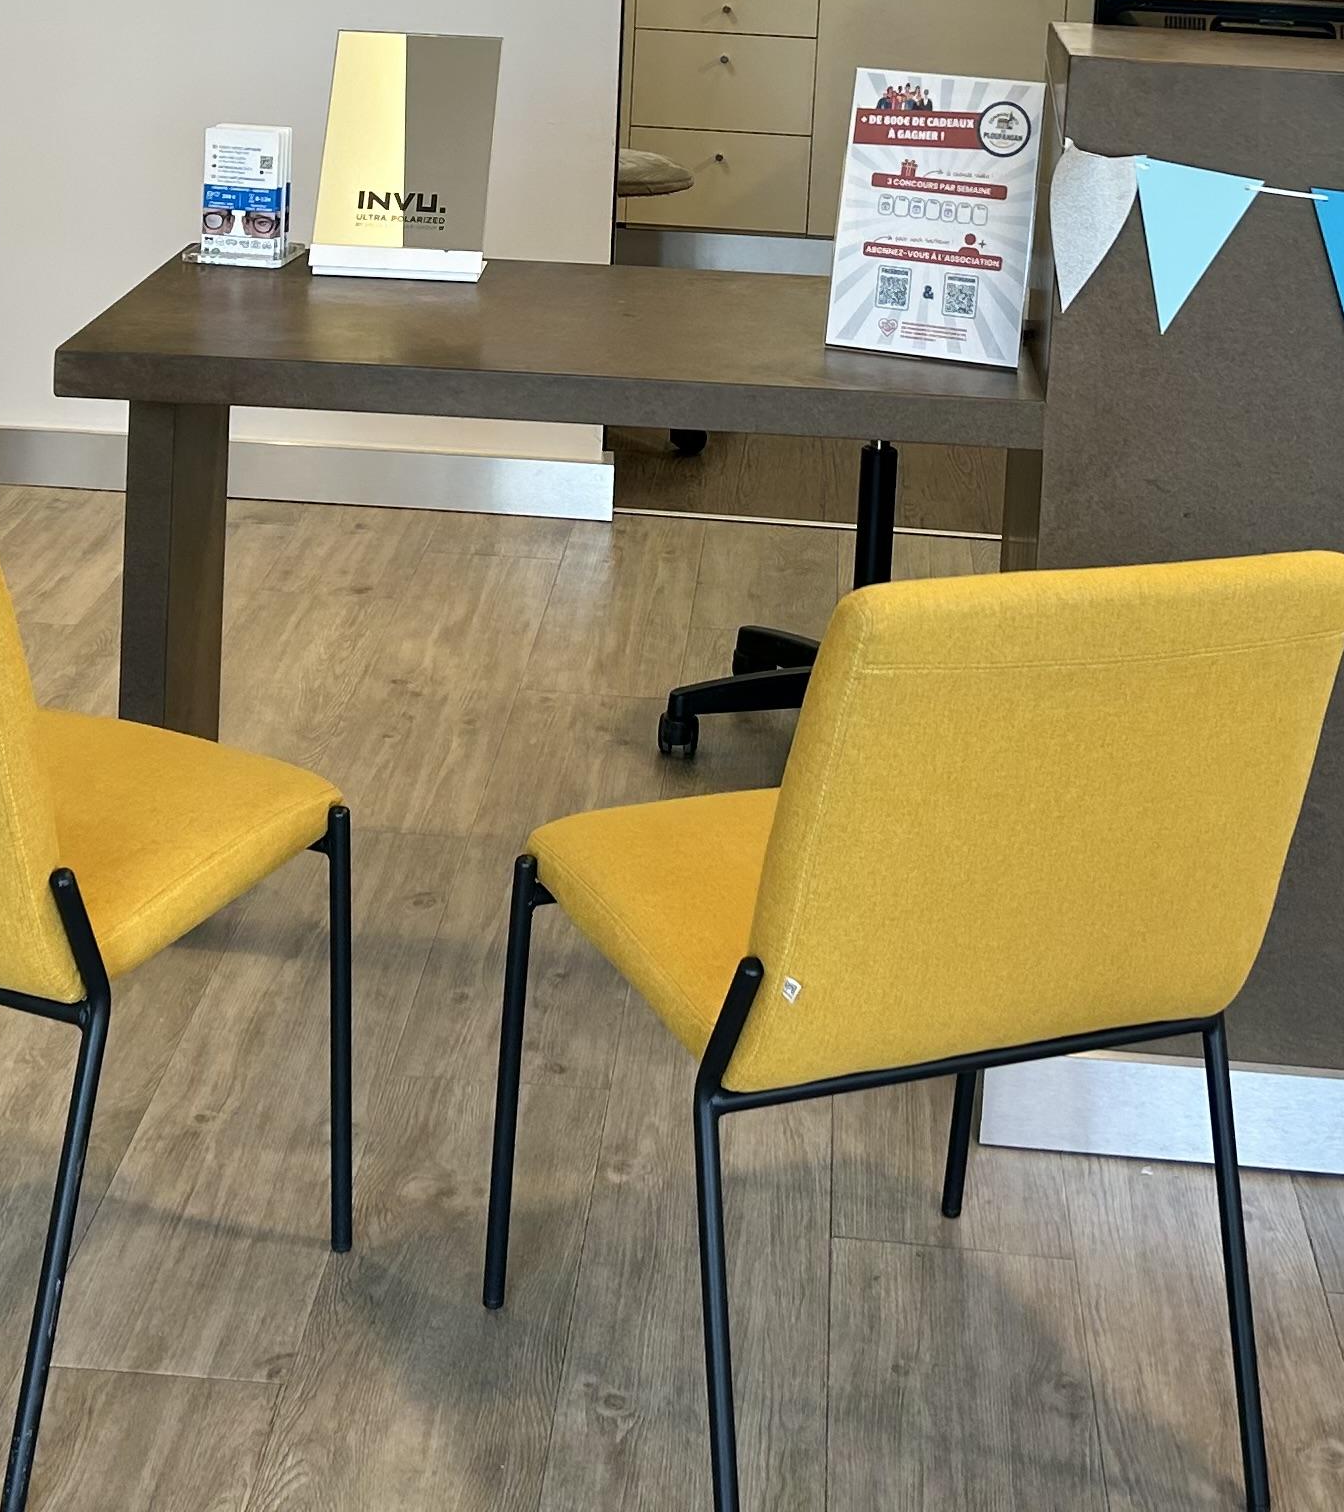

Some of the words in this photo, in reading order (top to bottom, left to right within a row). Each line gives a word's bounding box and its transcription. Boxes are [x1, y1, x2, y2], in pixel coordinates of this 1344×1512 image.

[869, 115, 882, 124] DE
[911, 117, 925, 127] DE
[926, 117, 975, 129] CADEAUX
[888, 128, 896, 139] À
[897, 130, 939, 141] GAGNER
[893, 179, 938, 190] CONCOURS
[940, 184, 956, 193] PAR
[957, 185, 992, 195] SEMAINE
[391, 215, 446, 225] POLARIZED
[938, 253, 1001, 268] L'ASSOCIATION
[922, 285, 934, 300] &
